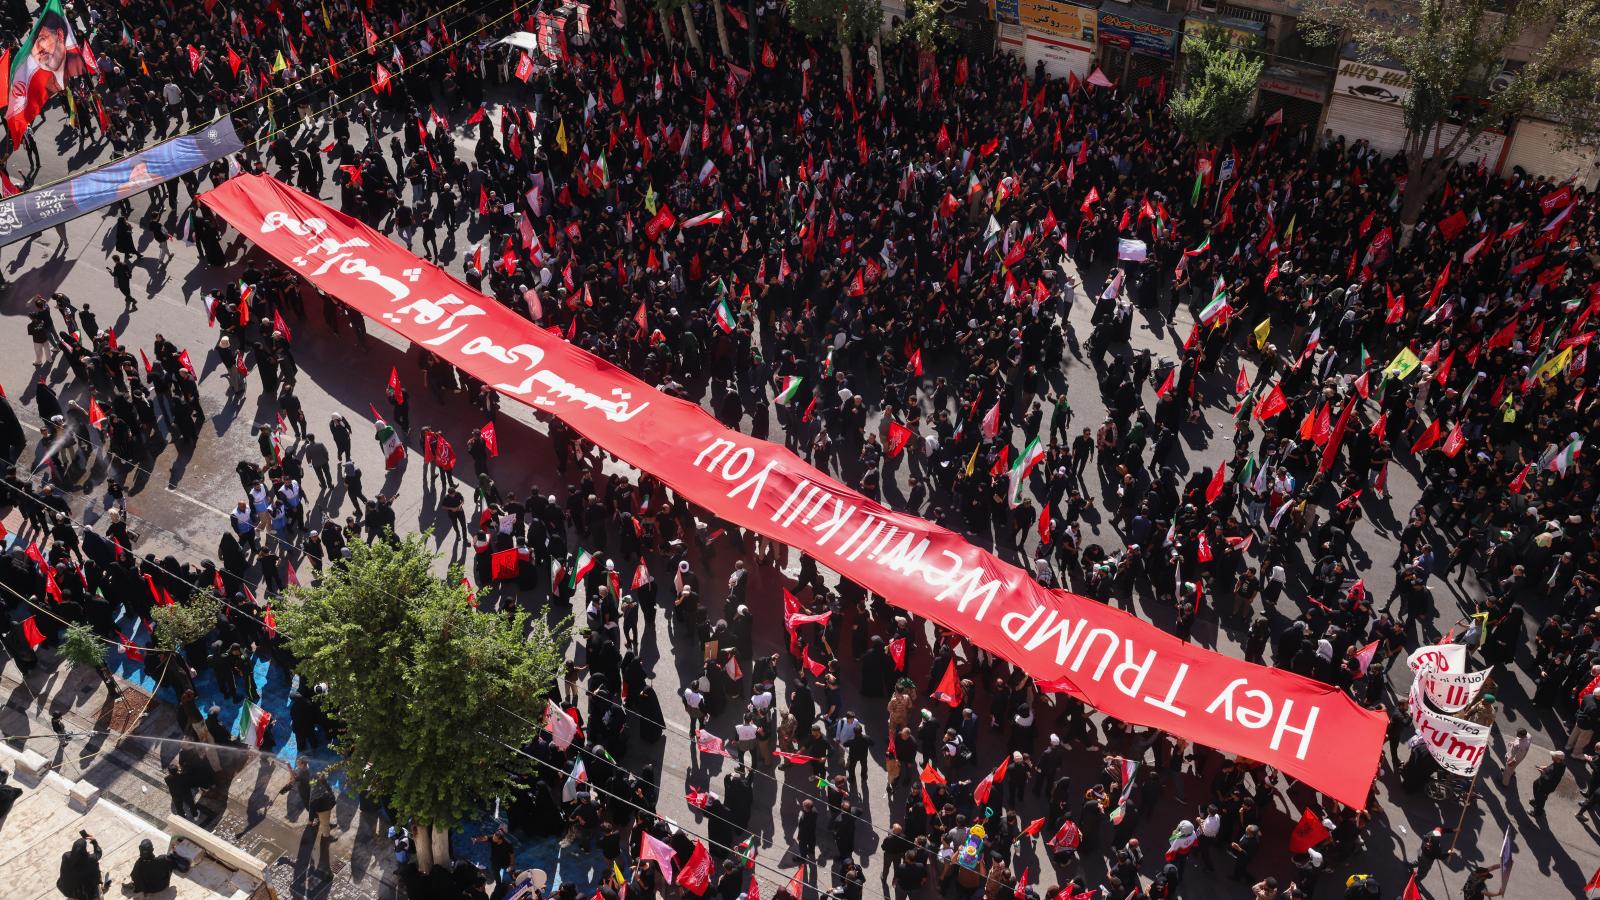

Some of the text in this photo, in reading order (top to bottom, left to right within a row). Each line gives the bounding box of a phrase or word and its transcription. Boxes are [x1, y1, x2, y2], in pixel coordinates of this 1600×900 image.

[1339, 63, 1379, 82] AUTO
[260, 211, 327, 241] هی
[291, 237, 422, 303] ترامپ
[693, 437, 779, 511] You
[922, 550, 1002, 622] We
[1000, 604, 1189, 718] TRUMP
[1205, 678, 1320, 761] Hey
